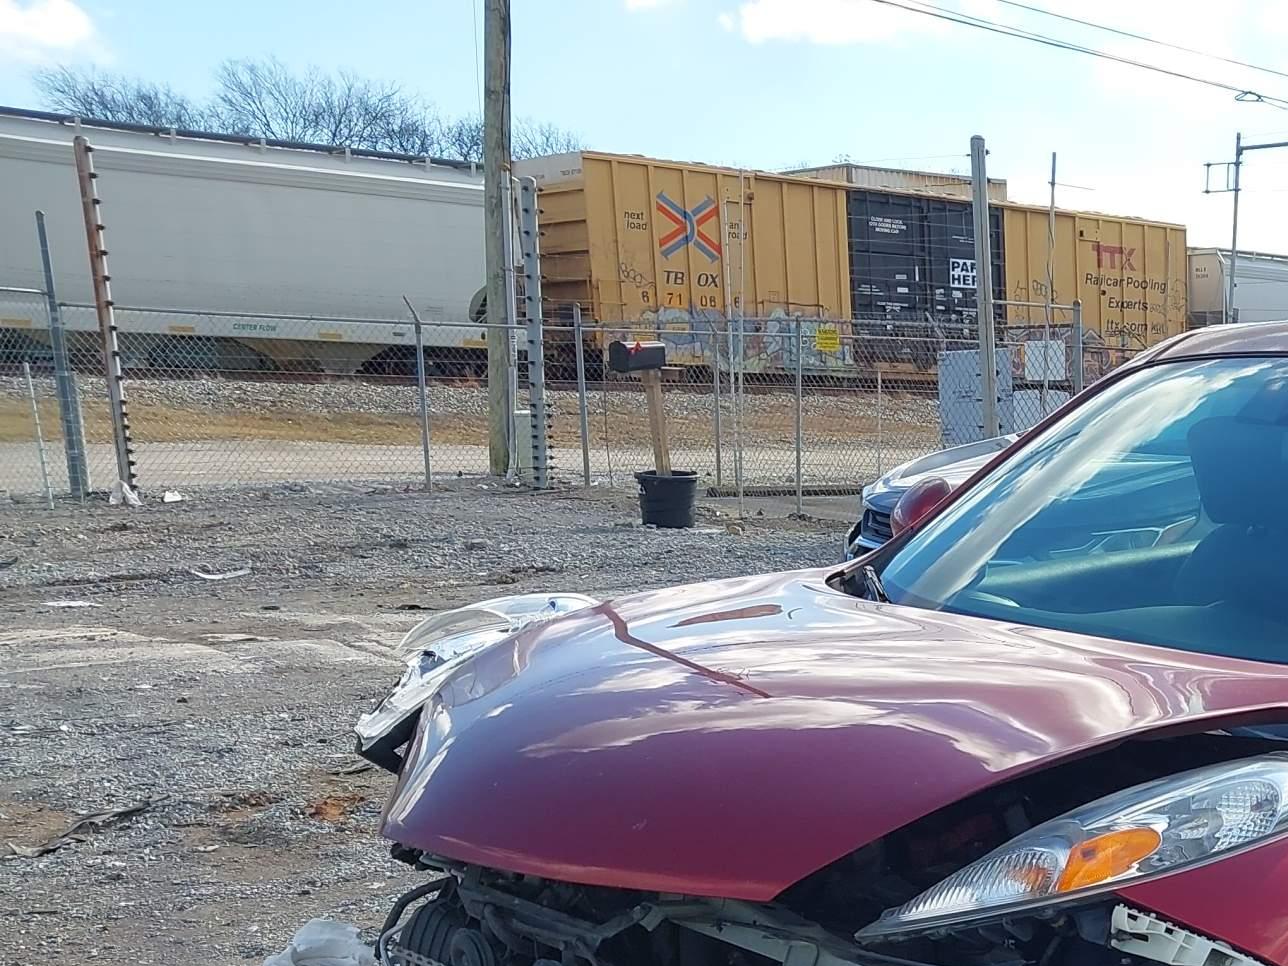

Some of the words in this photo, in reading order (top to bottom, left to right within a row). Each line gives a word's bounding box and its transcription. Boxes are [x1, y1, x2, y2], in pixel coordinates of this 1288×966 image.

[624, 210, 645, 221] next
[626, 220, 648, 231] load
[1092, 243, 1137, 272] TTX
[1085, 273, 1125, 288] Railcar
[1126, 277, 1167, 294] Pooling
[1108, 297, 1149, 313] Experts
